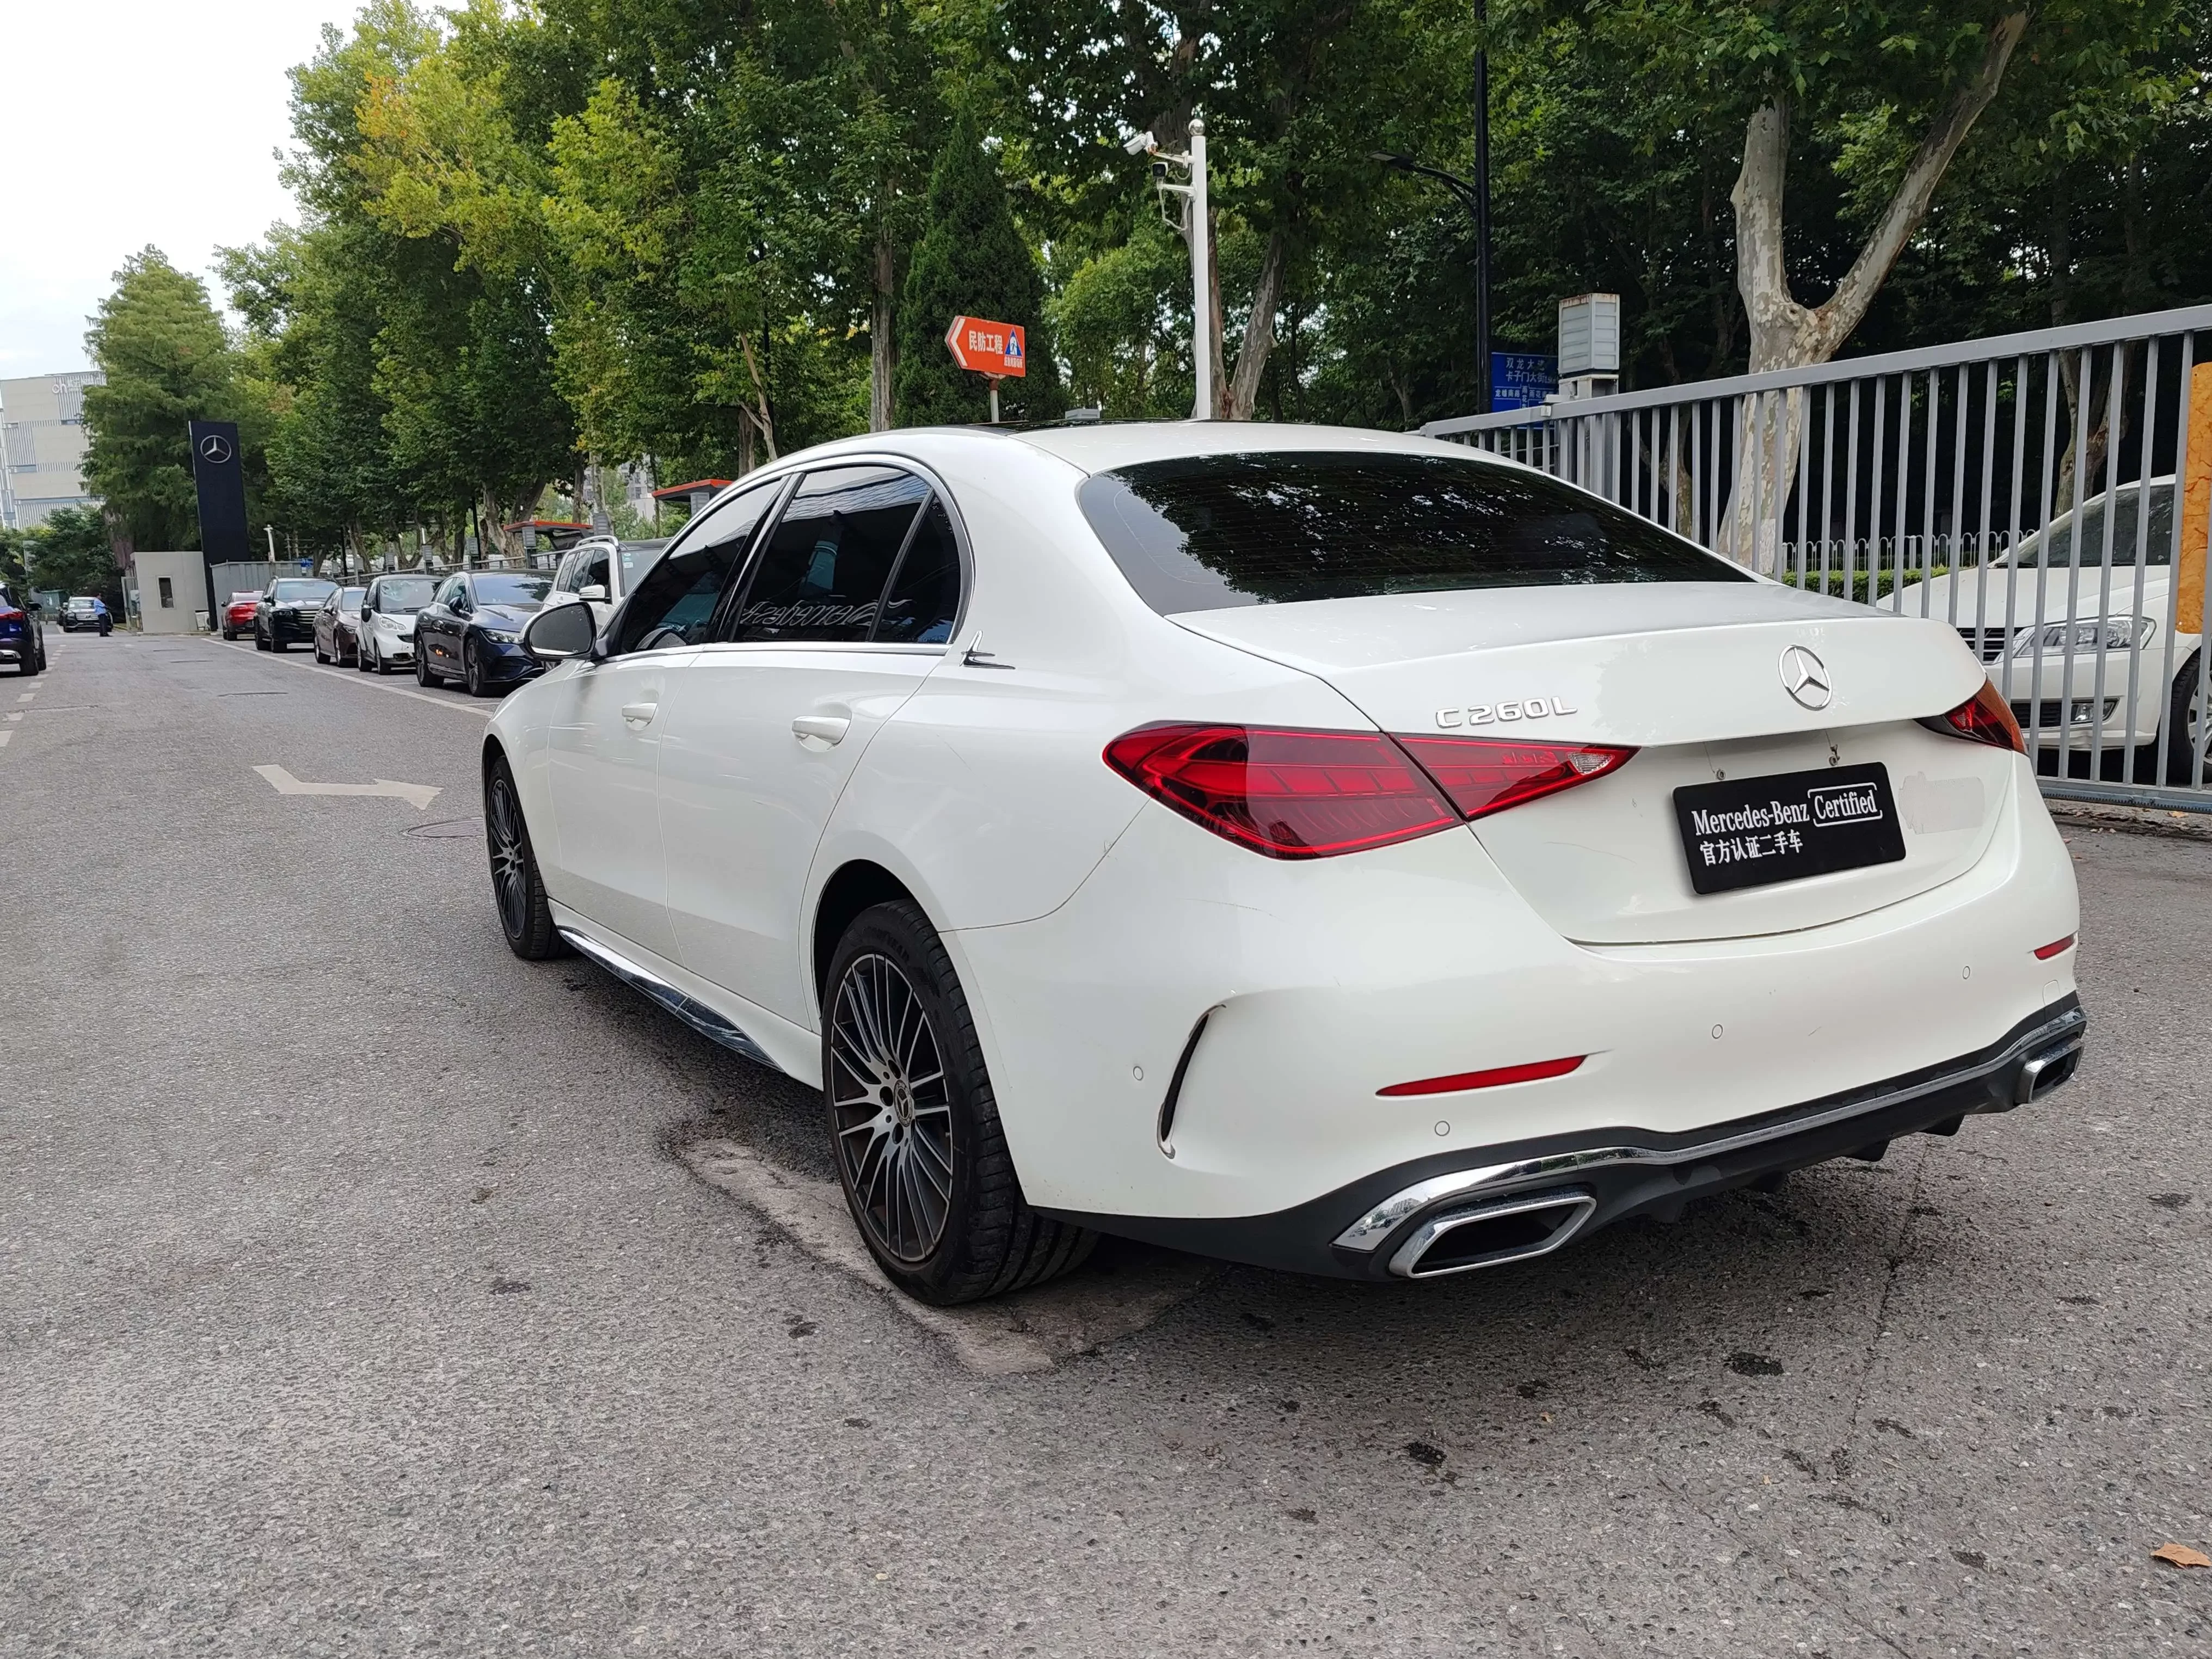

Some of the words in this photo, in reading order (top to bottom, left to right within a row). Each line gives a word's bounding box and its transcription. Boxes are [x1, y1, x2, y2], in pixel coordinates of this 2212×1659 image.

[968, 330, 1003, 355] 民防工程
[1691, 801, 1810, 836] Mercedes-Benz
[1814, 790, 1878, 819] Certified
[1699, 829, 1803, 867] 官方认证二手车
